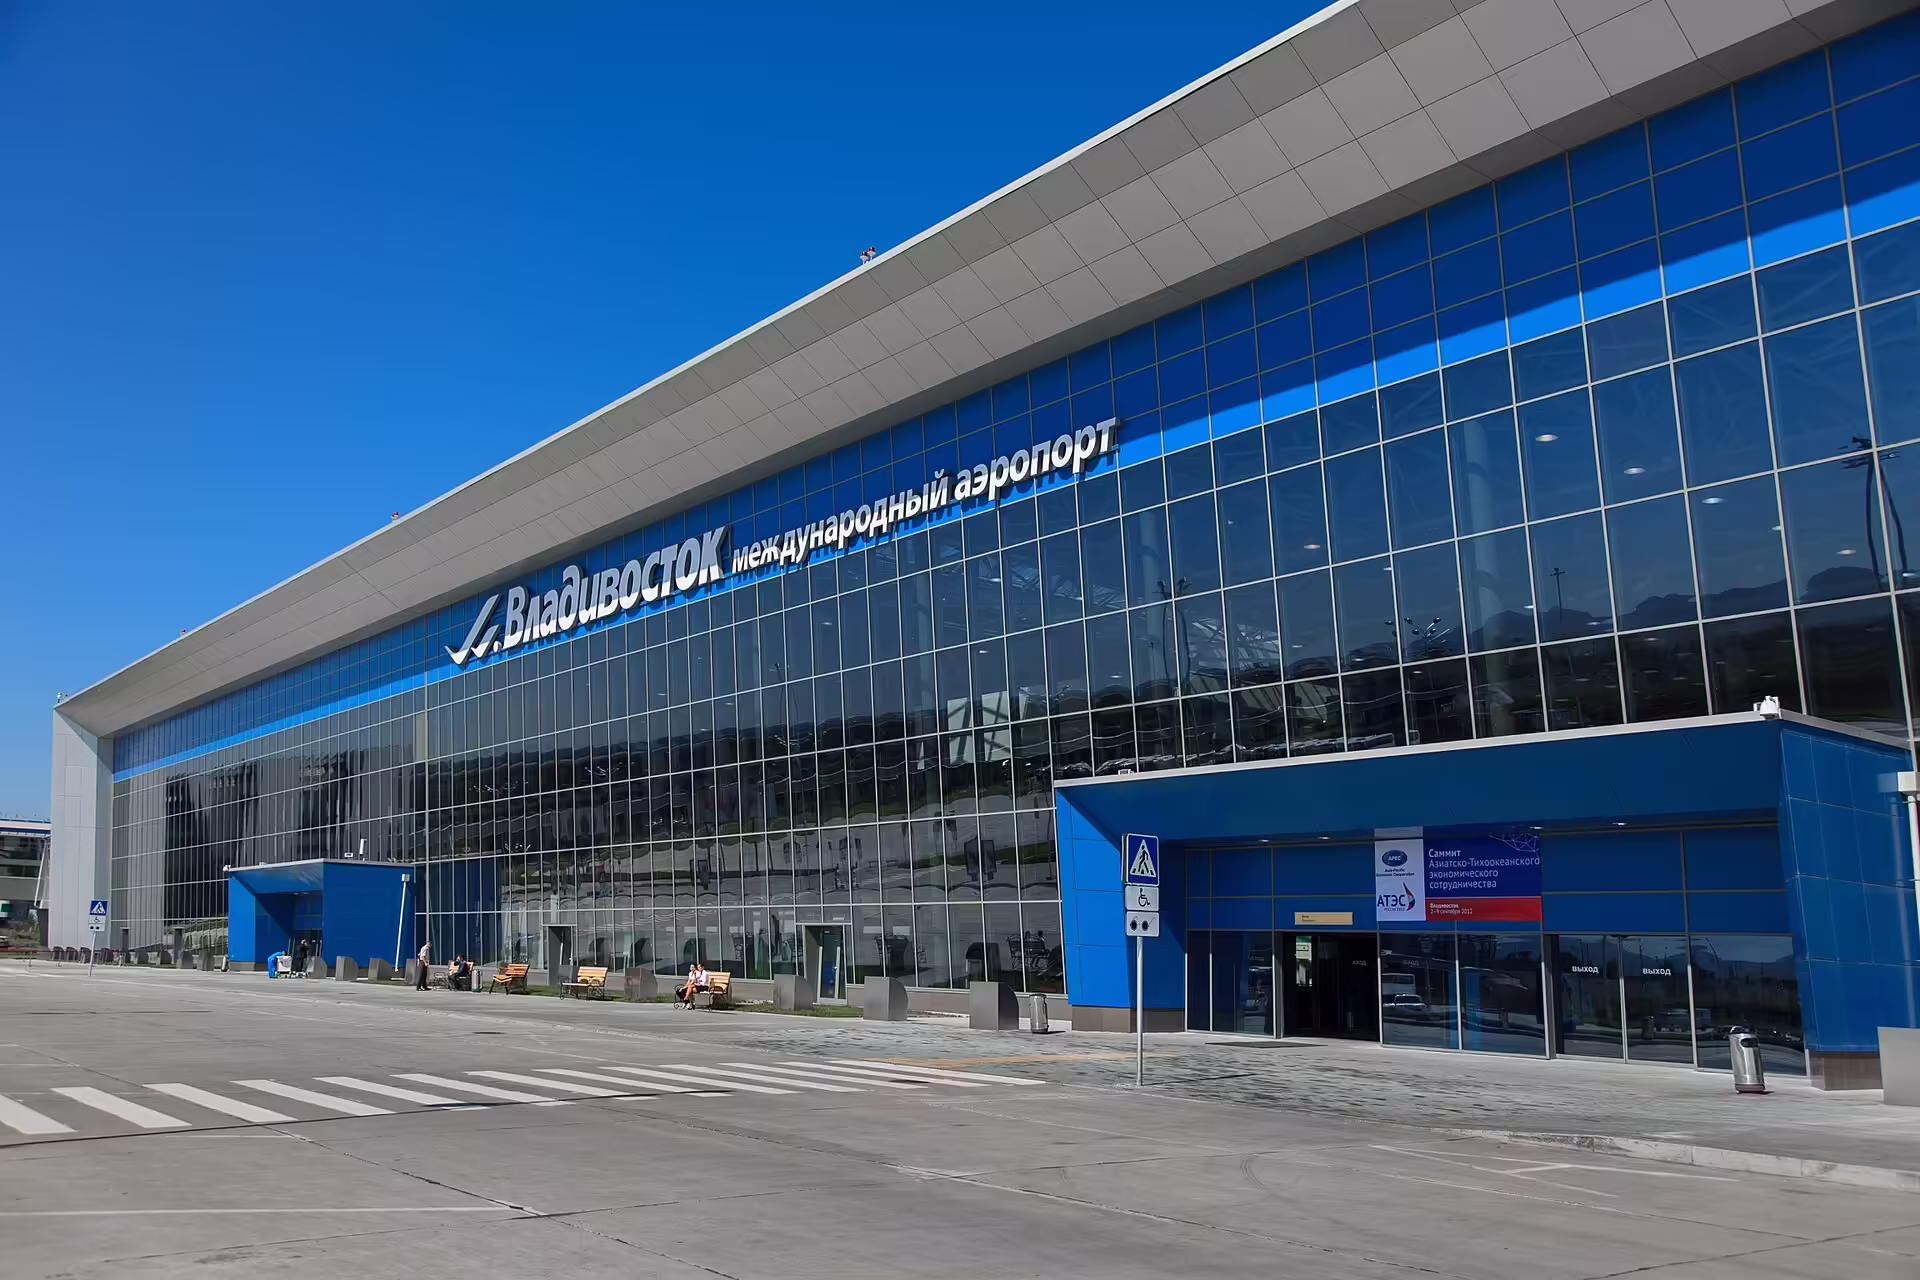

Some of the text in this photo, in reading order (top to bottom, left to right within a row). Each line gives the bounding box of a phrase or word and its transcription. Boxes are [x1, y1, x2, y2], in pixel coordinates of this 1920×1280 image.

[502, 415, 1121, 650] Владивосток международный аэропорт
[1428, 848, 1461, 858] Саммит
[1428, 857, 1540, 868] Азиатско-Тихоокеанского
[1429, 869, 1499, 879] экономического
[1429, 880, 1497, 891] сотрудничества
[1377, 894, 1406, 907] АТЭС
[1461, 907, 1473, 915] 2012
[1571, 965, 1600, 974] выход
[1642, 968, 1672, 976] выход
